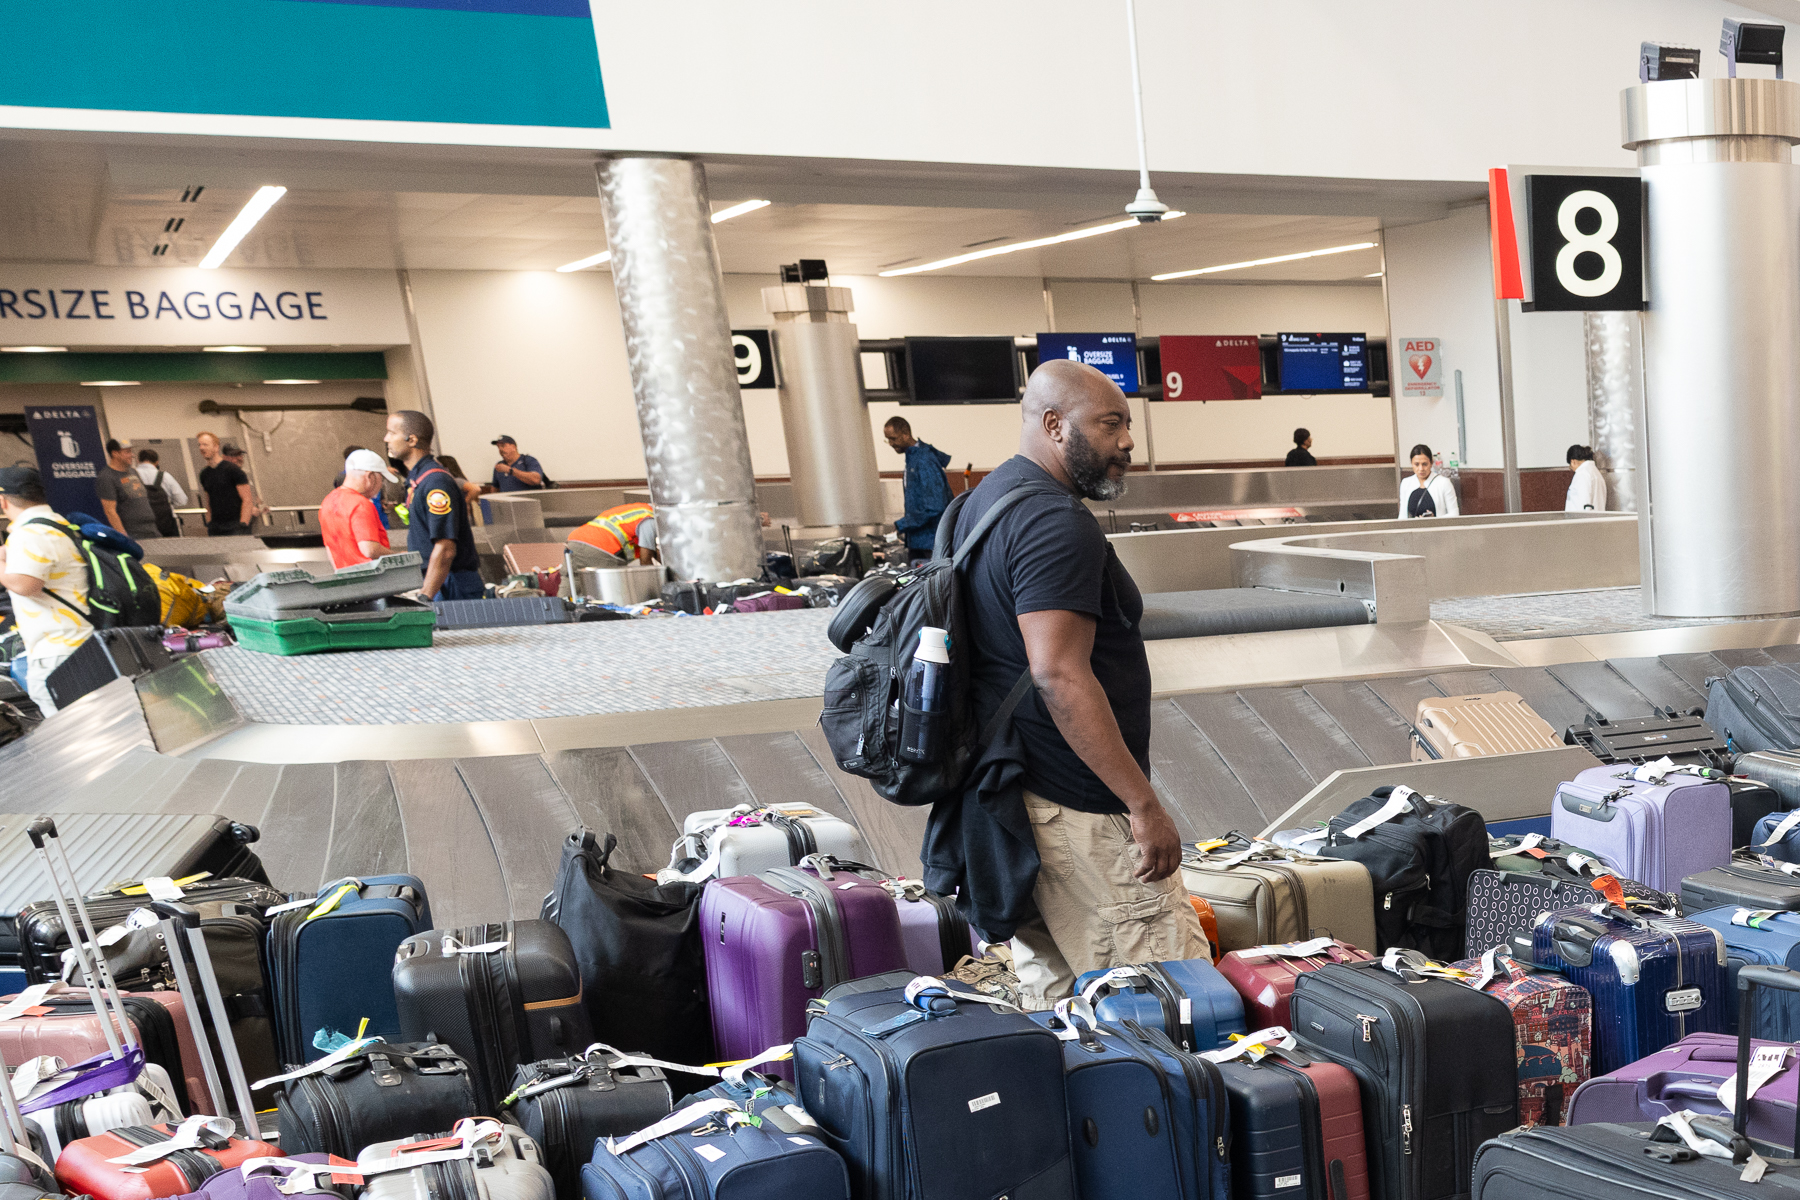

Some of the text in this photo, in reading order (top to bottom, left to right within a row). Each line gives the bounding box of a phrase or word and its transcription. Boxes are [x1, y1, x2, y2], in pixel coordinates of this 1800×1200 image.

[1555, 190, 1623, 297] 8
[125, 291, 328, 320] BAGGAGE
[732, 334, 762, 384] 9
[1405, 341, 1435, 352] AED
[1165, 371, 1183, 398] 9
[43, 410, 81, 419] DELTA
